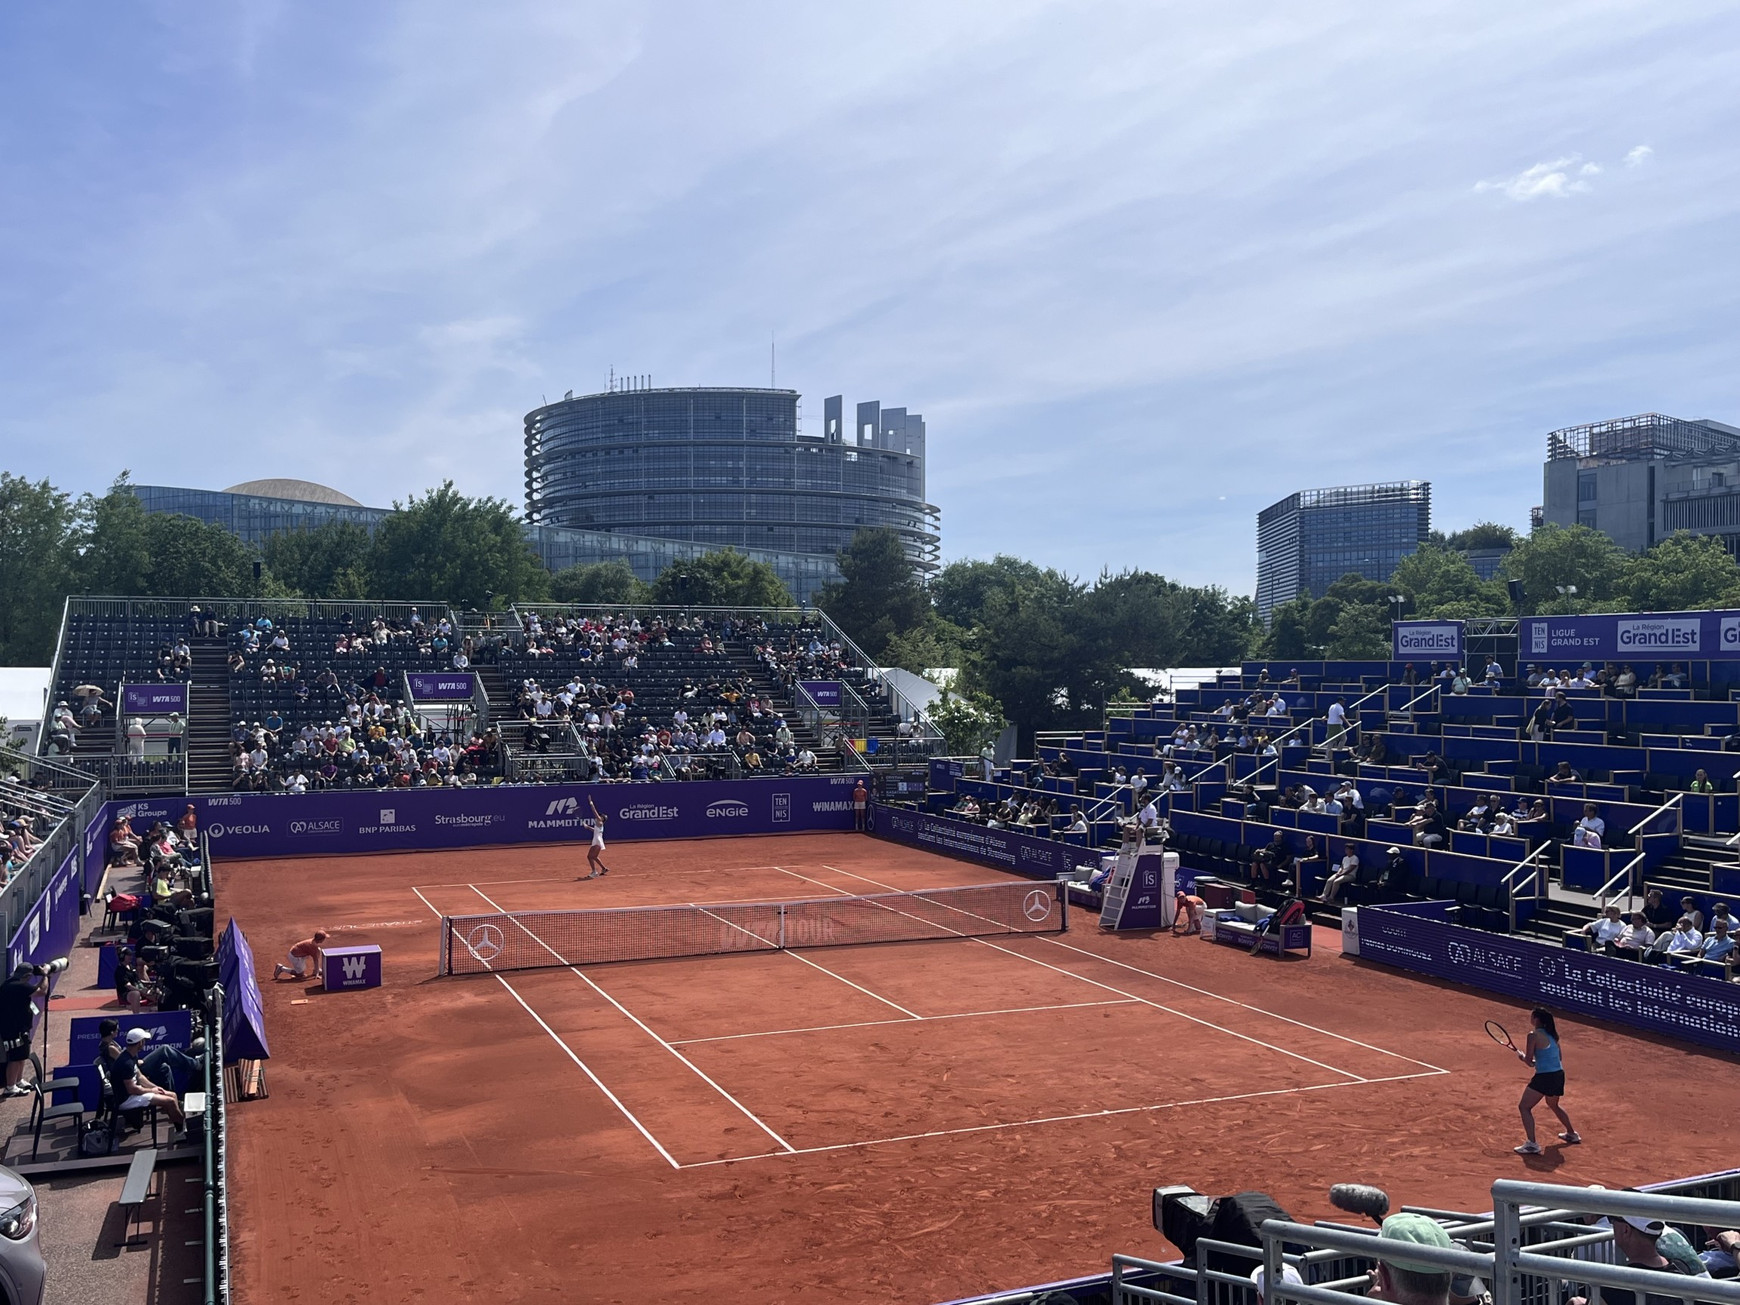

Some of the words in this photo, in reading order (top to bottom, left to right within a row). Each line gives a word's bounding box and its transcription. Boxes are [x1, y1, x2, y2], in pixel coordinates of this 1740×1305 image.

[1534, 626, 1545, 635] TEN
[1534, 640, 1545, 649] NIS
[1552, 638, 1581, 646] GRAND
[1584, 638, 1600, 646] EST
[438, 682, 456, 690] WTA
[456, 682, 467, 690] 500
[208, 798, 229, 806] WTA
[230, 797, 242, 806] 500
[813, 800, 854, 812] WINAMAX
[138, 810, 167, 818] Groupe
[775, 809, 787, 818] NIS
[226, 824, 270, 834] VEOLIA
[308, 820, 340, 830] ALSACE
[359, 826, 377, 834] BNP
[379, 824, 416, 832] PARIBAS
[1586, 968, 1681, 1005] Collectivité
